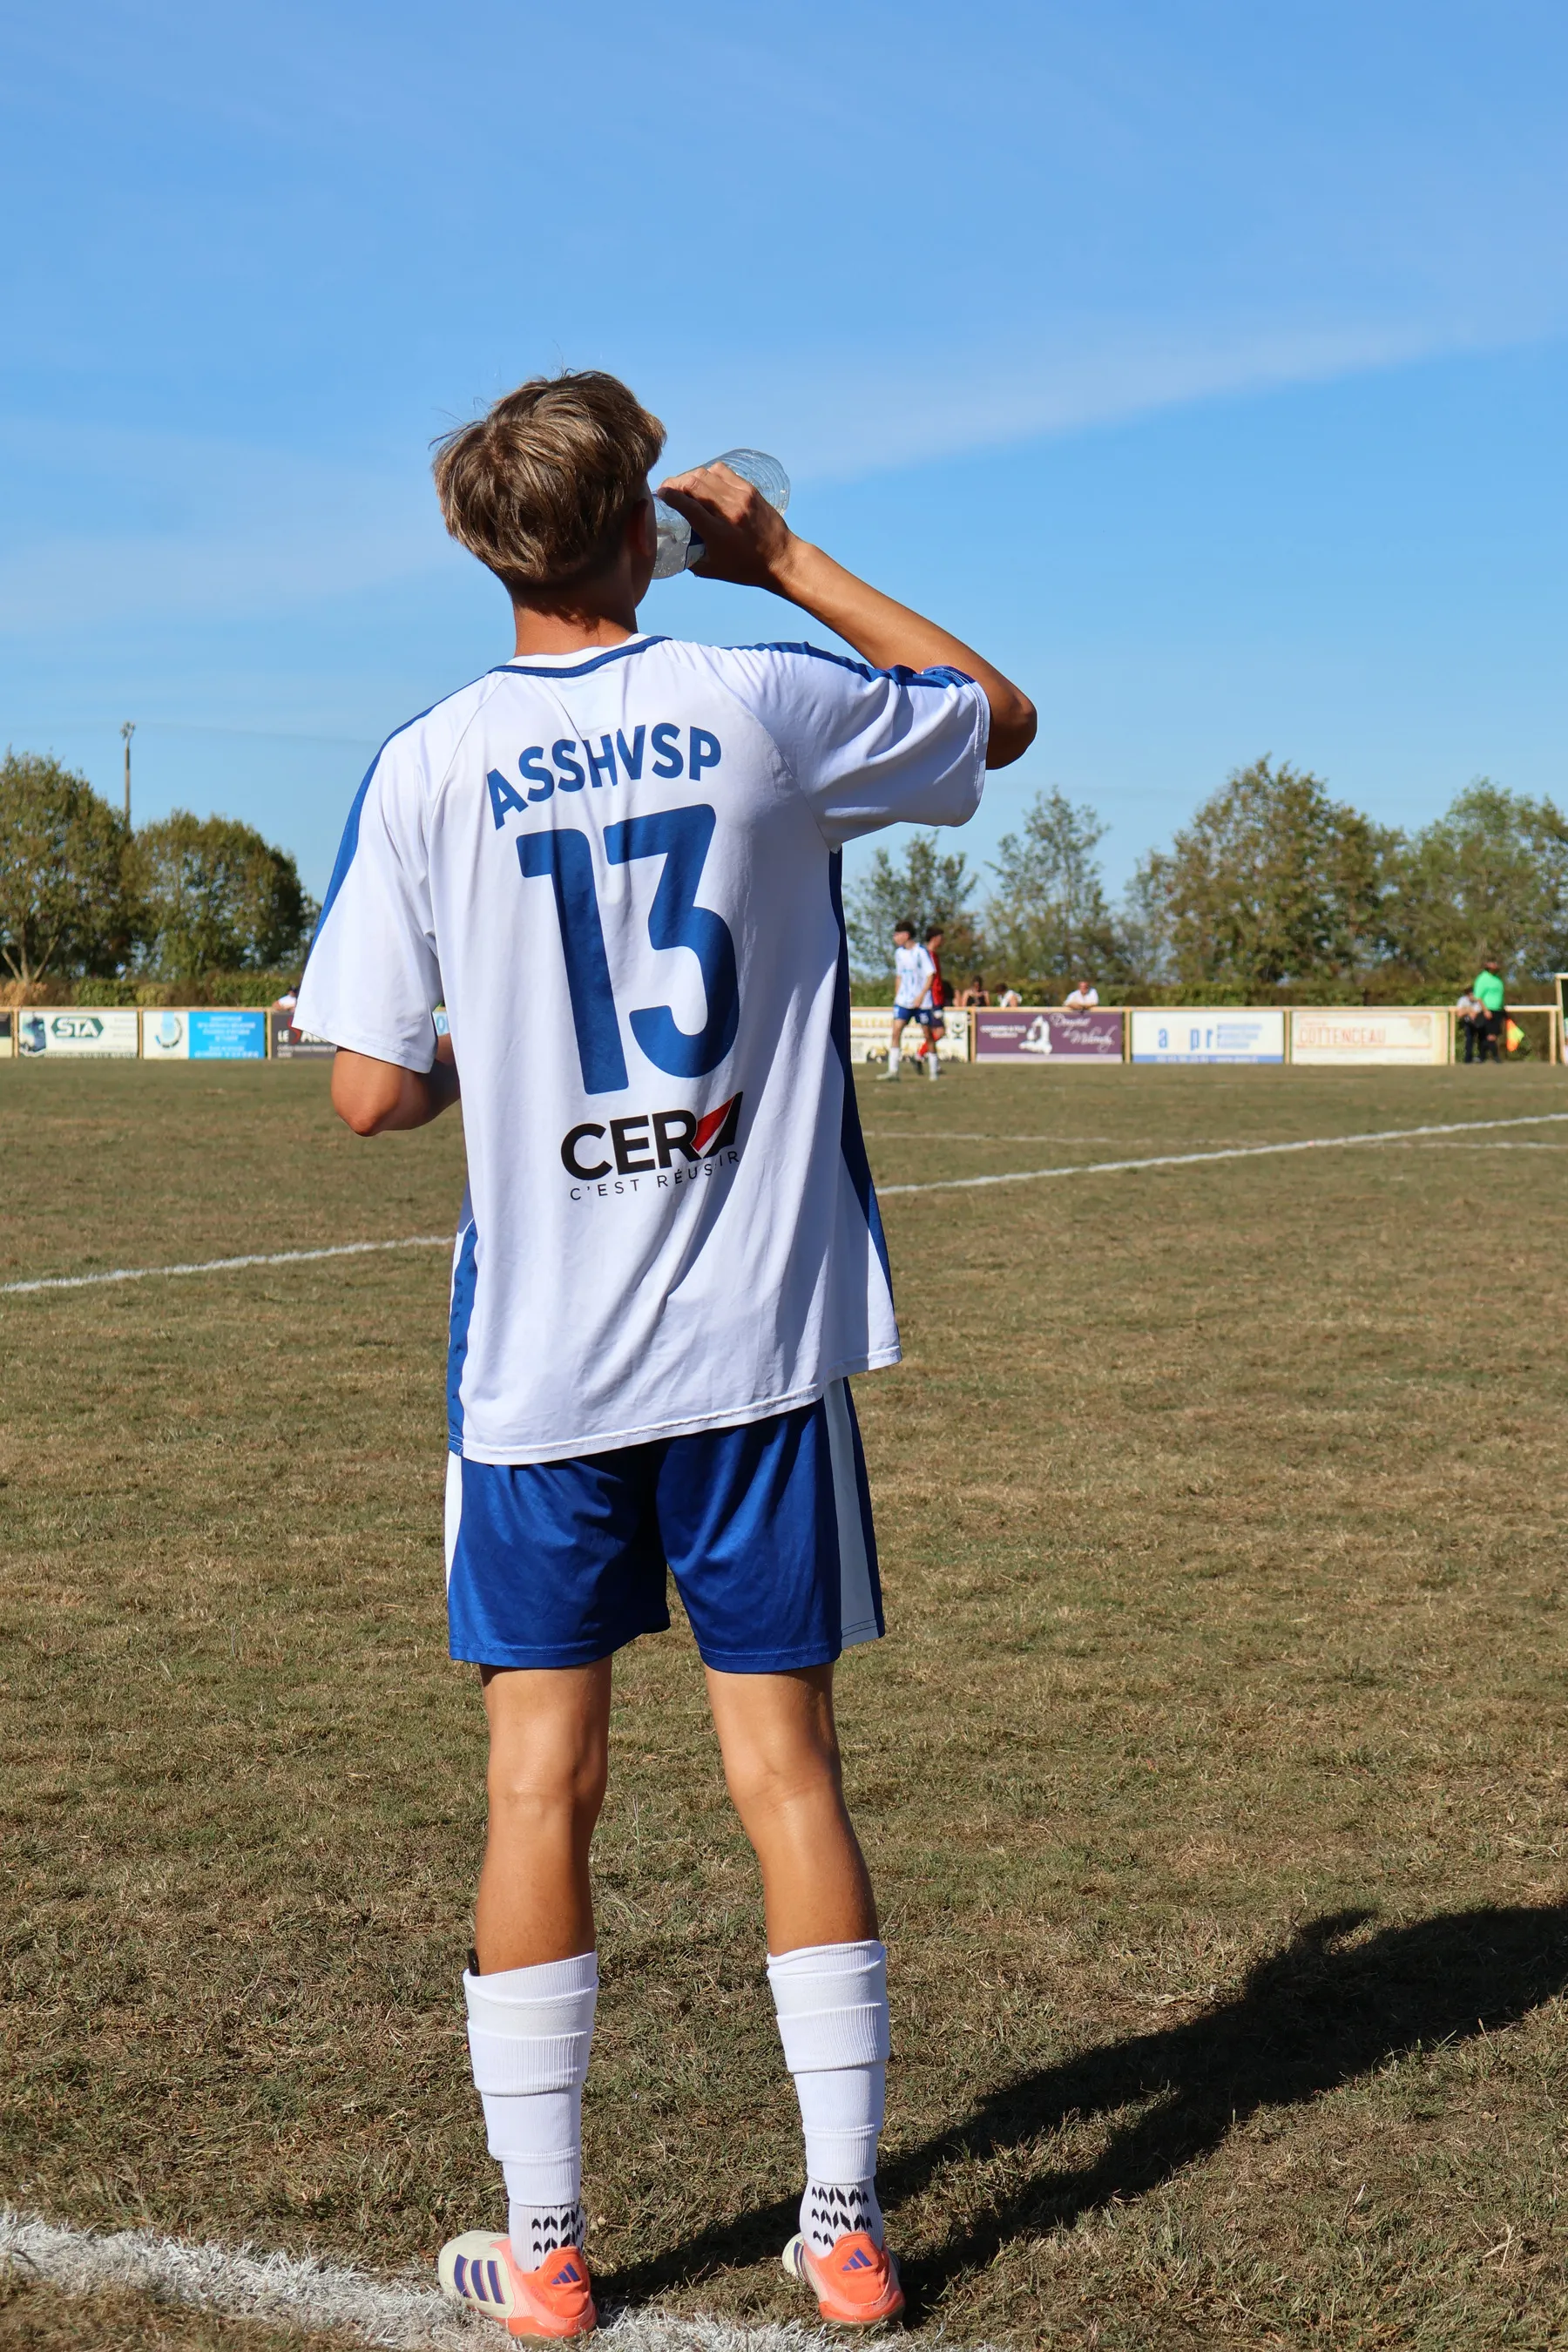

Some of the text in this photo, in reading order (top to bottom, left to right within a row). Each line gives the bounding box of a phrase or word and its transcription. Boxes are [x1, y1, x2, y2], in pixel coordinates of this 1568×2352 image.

[485, 722, 722, 831] ASSHVSP
[515, 803, 740, 1096] 13
[55, 1017, 98, 1037] STA
[1299, 1026, 1386, 1044] COTTENCEAU
[570, 1150, 740, 1201] C'EST RÉUSIR
